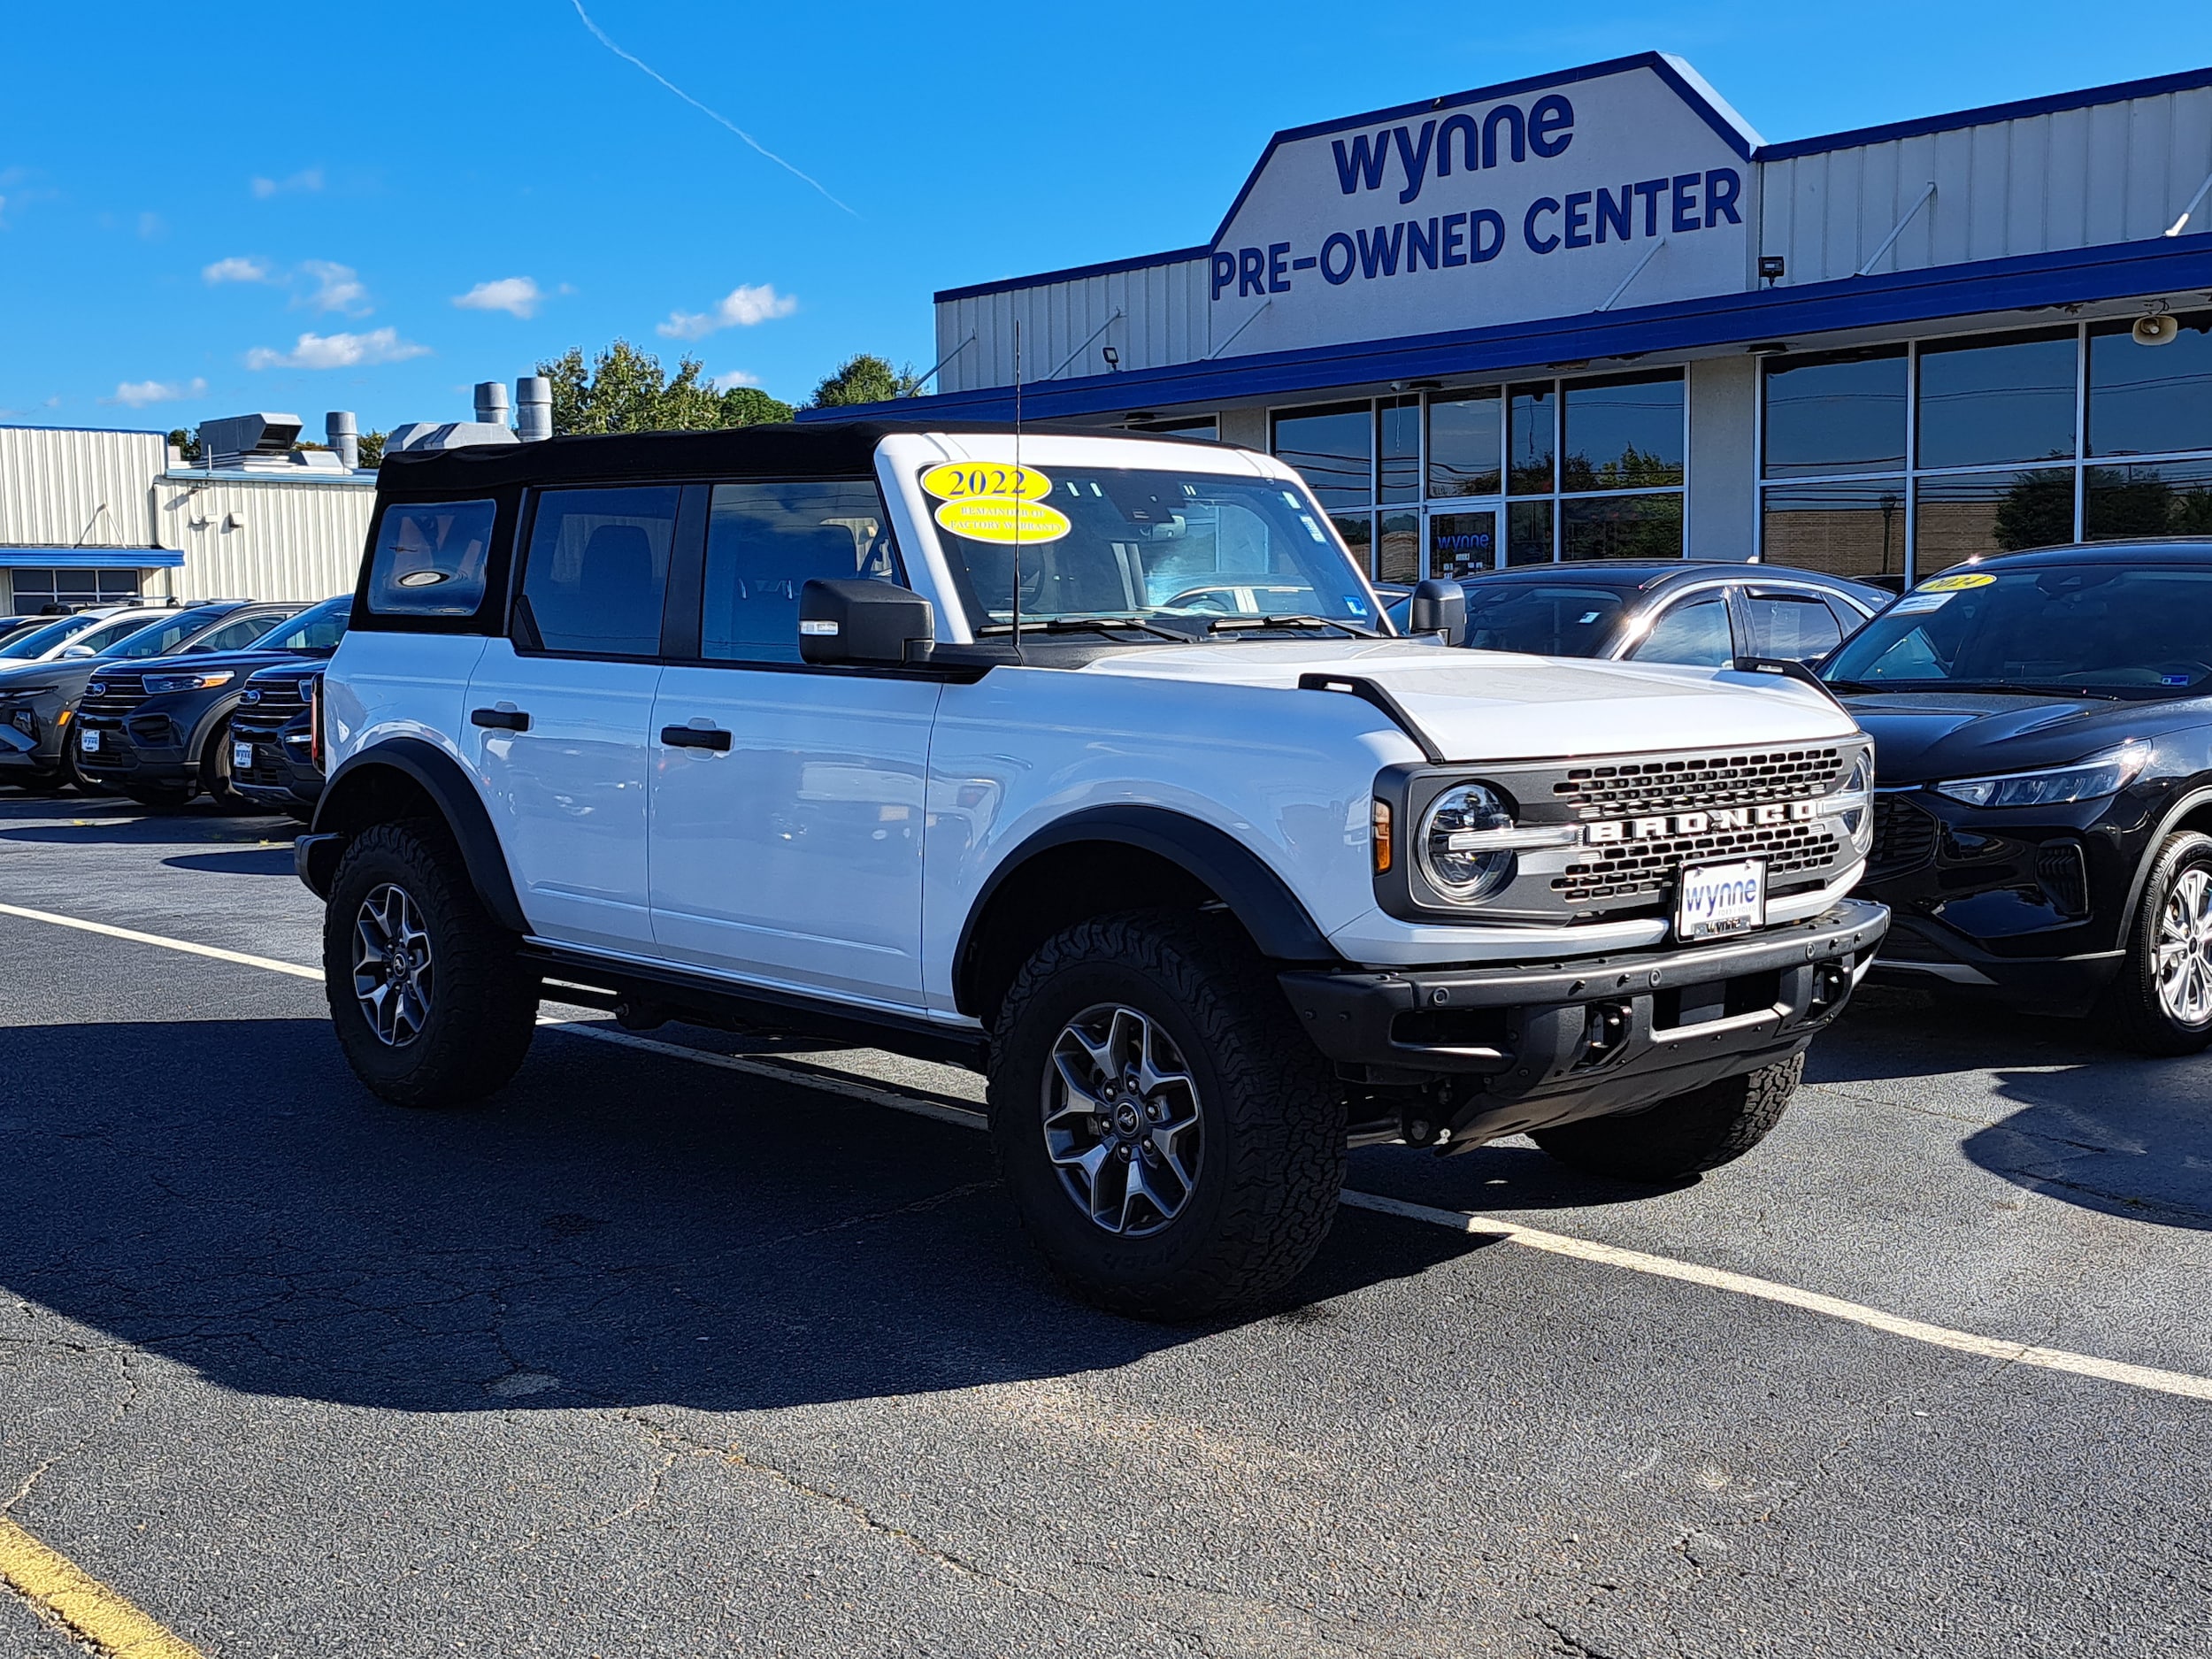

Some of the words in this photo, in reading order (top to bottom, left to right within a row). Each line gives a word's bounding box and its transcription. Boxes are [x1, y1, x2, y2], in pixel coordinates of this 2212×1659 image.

[1332, 94, 1575, 204] wynne
[1211, 209, 1505, 301] PRE-OWNED
[1524, 167, 1742, 255] CENTER
[948, 470, 1027, 495] 2022
[950, 519, 1000, 530] FACTORY
[1437, 534, 1489, 552] wynne
[1587, 800, 1816, 843] BRONCO
[1686, 879, 1757, 918] wynne
